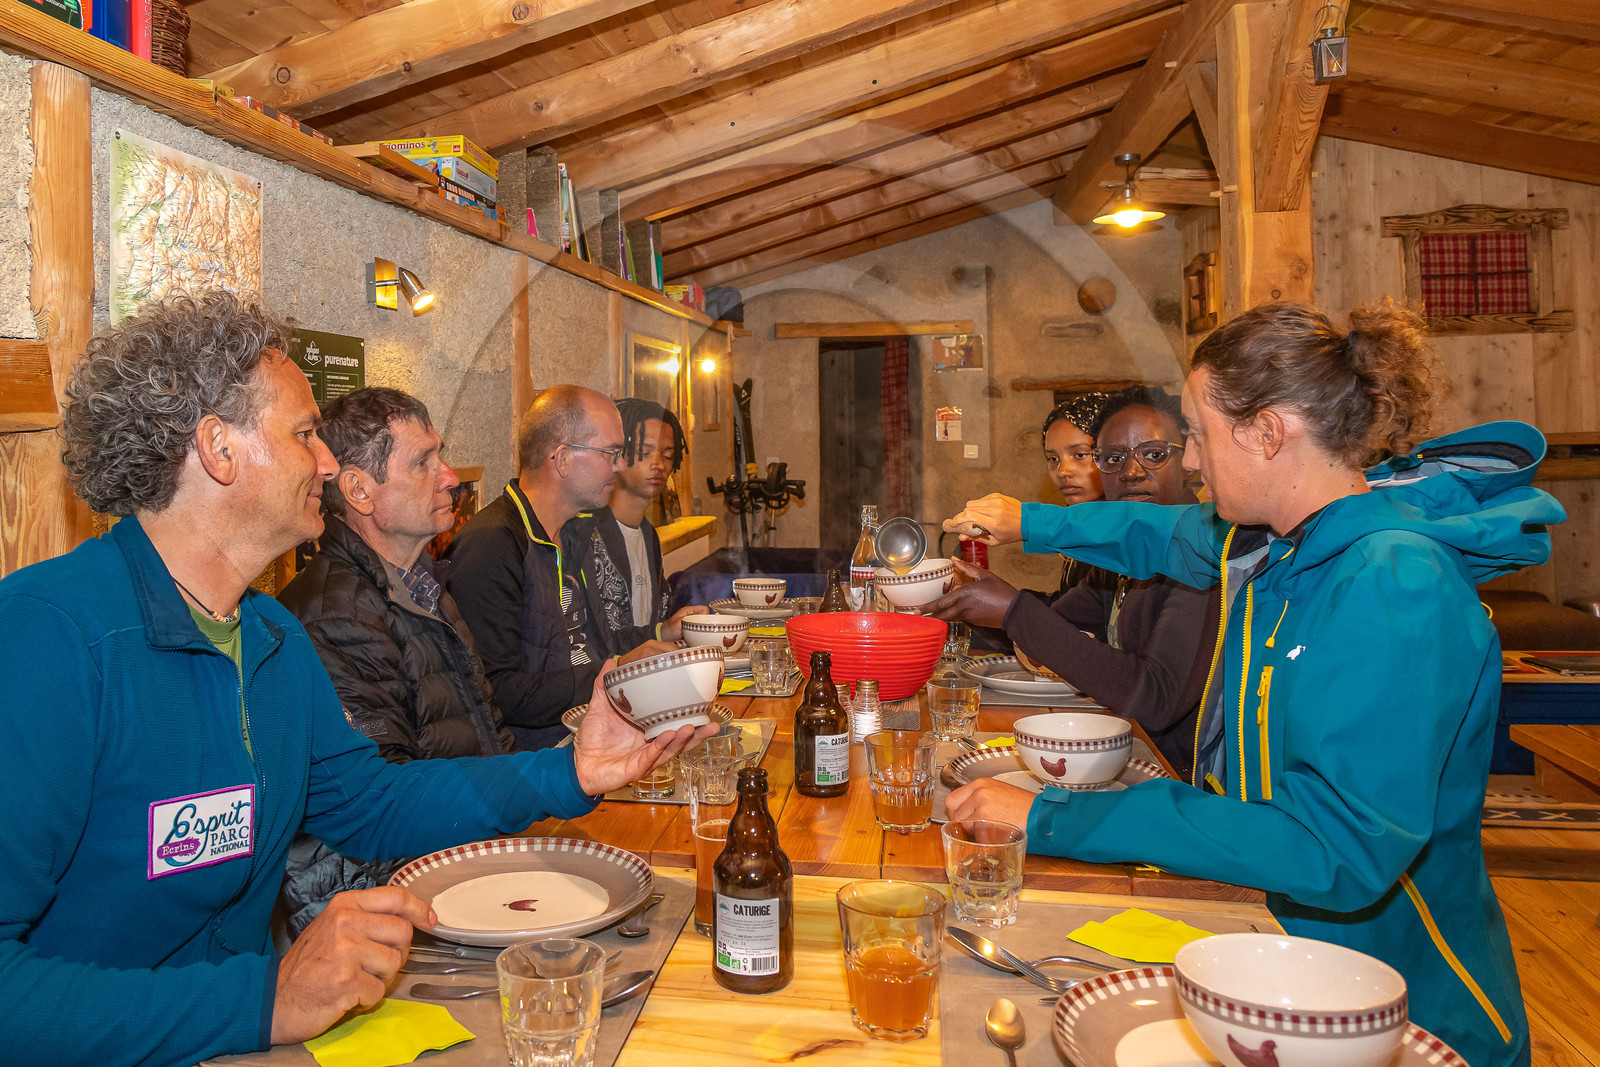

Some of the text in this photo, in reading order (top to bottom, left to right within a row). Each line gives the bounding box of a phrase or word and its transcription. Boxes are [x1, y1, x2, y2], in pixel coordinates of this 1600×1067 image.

[383, 141, 426, 151] riominos
[324, 355, 359, 367] purenature
[210, 825, 250, 847] PARC
[162, 841, 195, 856] Ecrins
[210, 840, 250, 856] NATIONAL
[733, 904, 771, 917] CATURIGE
